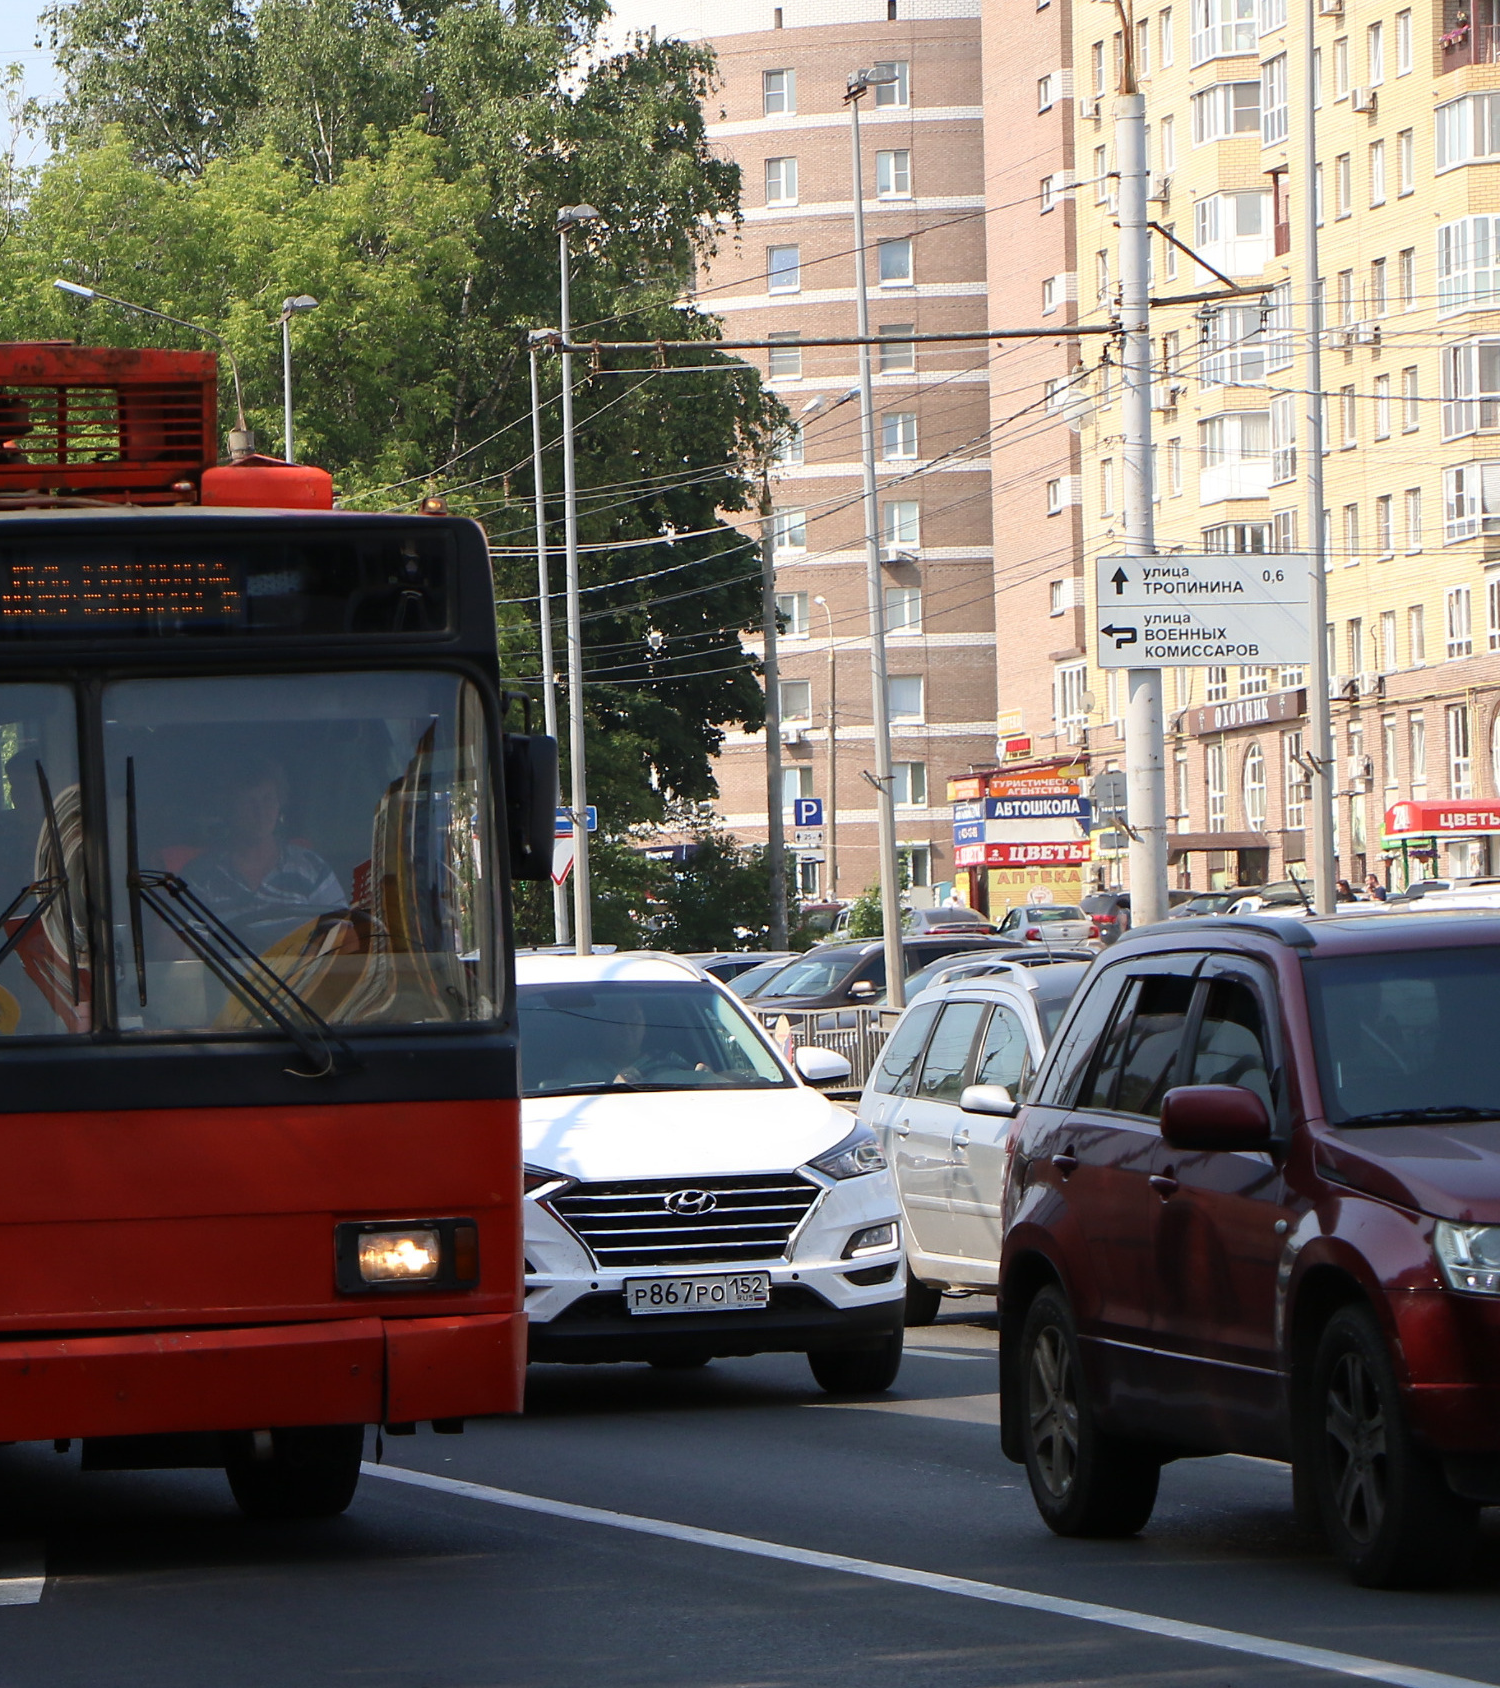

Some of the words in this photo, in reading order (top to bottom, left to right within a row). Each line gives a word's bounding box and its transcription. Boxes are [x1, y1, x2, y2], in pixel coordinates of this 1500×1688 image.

[1143, 567, 1189, 581] улица
[1262, 569, 1284, 584] 0,6
[1143, 580, 1244, 595] ТРОПИНИНА
[1144, 613, 1190, 627] улица
[1145, 627, 1227, 641] ВОЕННЫХ
[1145, 643, 1260, 659] КОМИССАРОВ
[1214, 697, 1269, 729] ОХОТНИК
[1007, 786, 1069, 796] АГЕНТСТВО
[995, 798, 1081, 817] АВТОШКОЛА
[1008, 843, 1091, 863] ЦВЕТЫ
[997, 869, 1082, 885] АПТЕКА
[634, 1281, 725, 1306] Р867РО
[729, 1276, 763, 1295] 152
